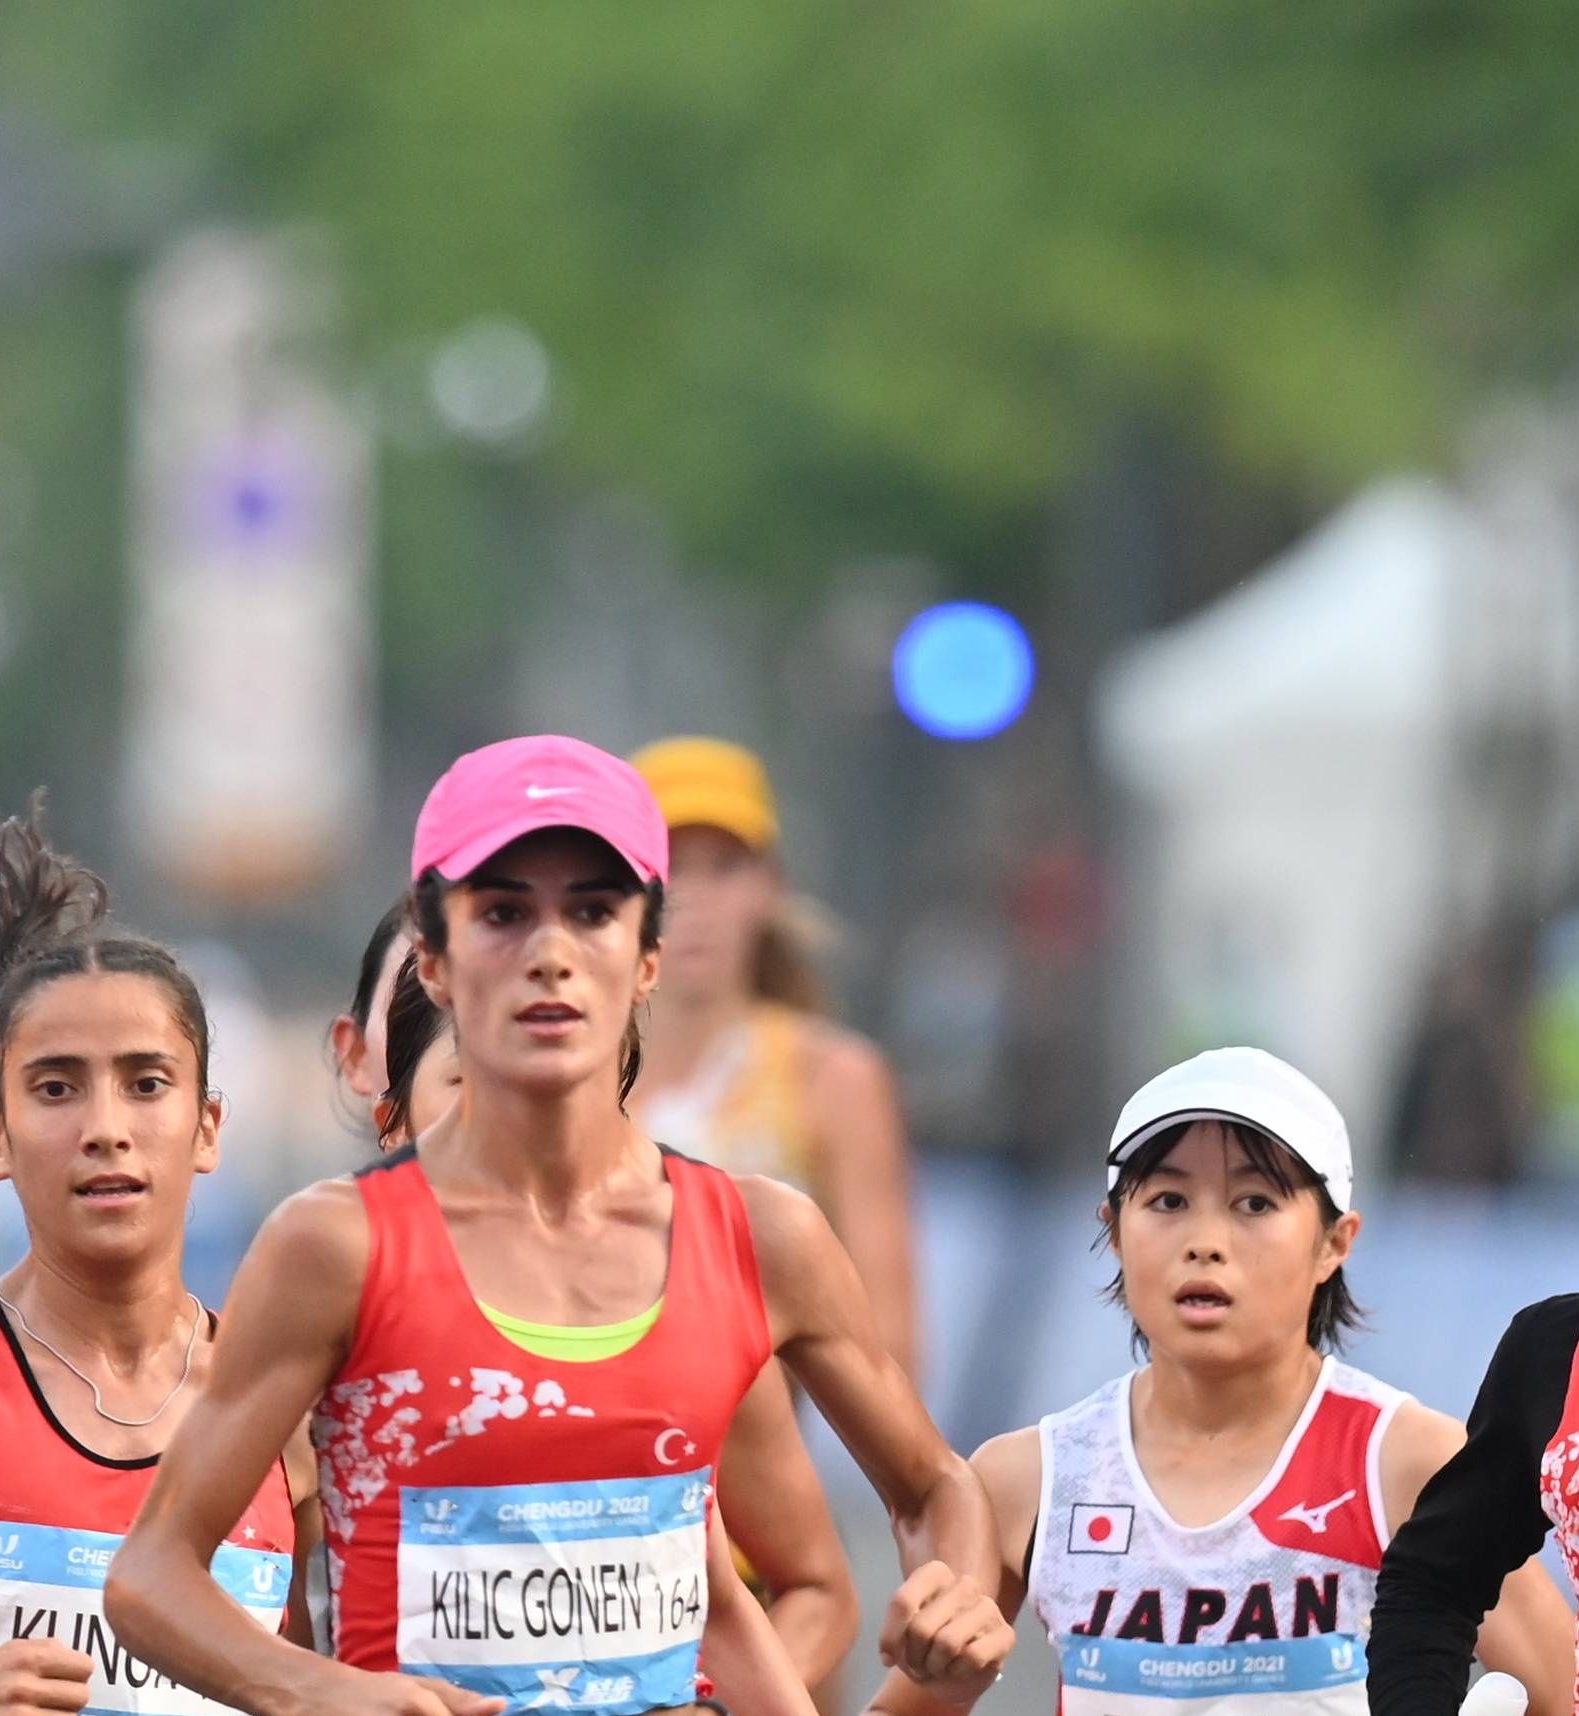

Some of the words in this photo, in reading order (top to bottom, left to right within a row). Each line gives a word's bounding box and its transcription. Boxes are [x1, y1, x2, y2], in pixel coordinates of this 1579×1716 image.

[497, 1498, 602, 1521] CHENGDU
[608, 1495, 649, 1514] 2021
[431, 1569, 515, 1640] KILIC
[522, 1562, 641, 1638] GONEN
[655, 1573, 701, 1634] 164
[1071, 1574, 1341, 1646] JAPAN
[1139, 1658, 1236, 1678] CHENGDU
[1241, 1655, 1286, 1674] 2021
